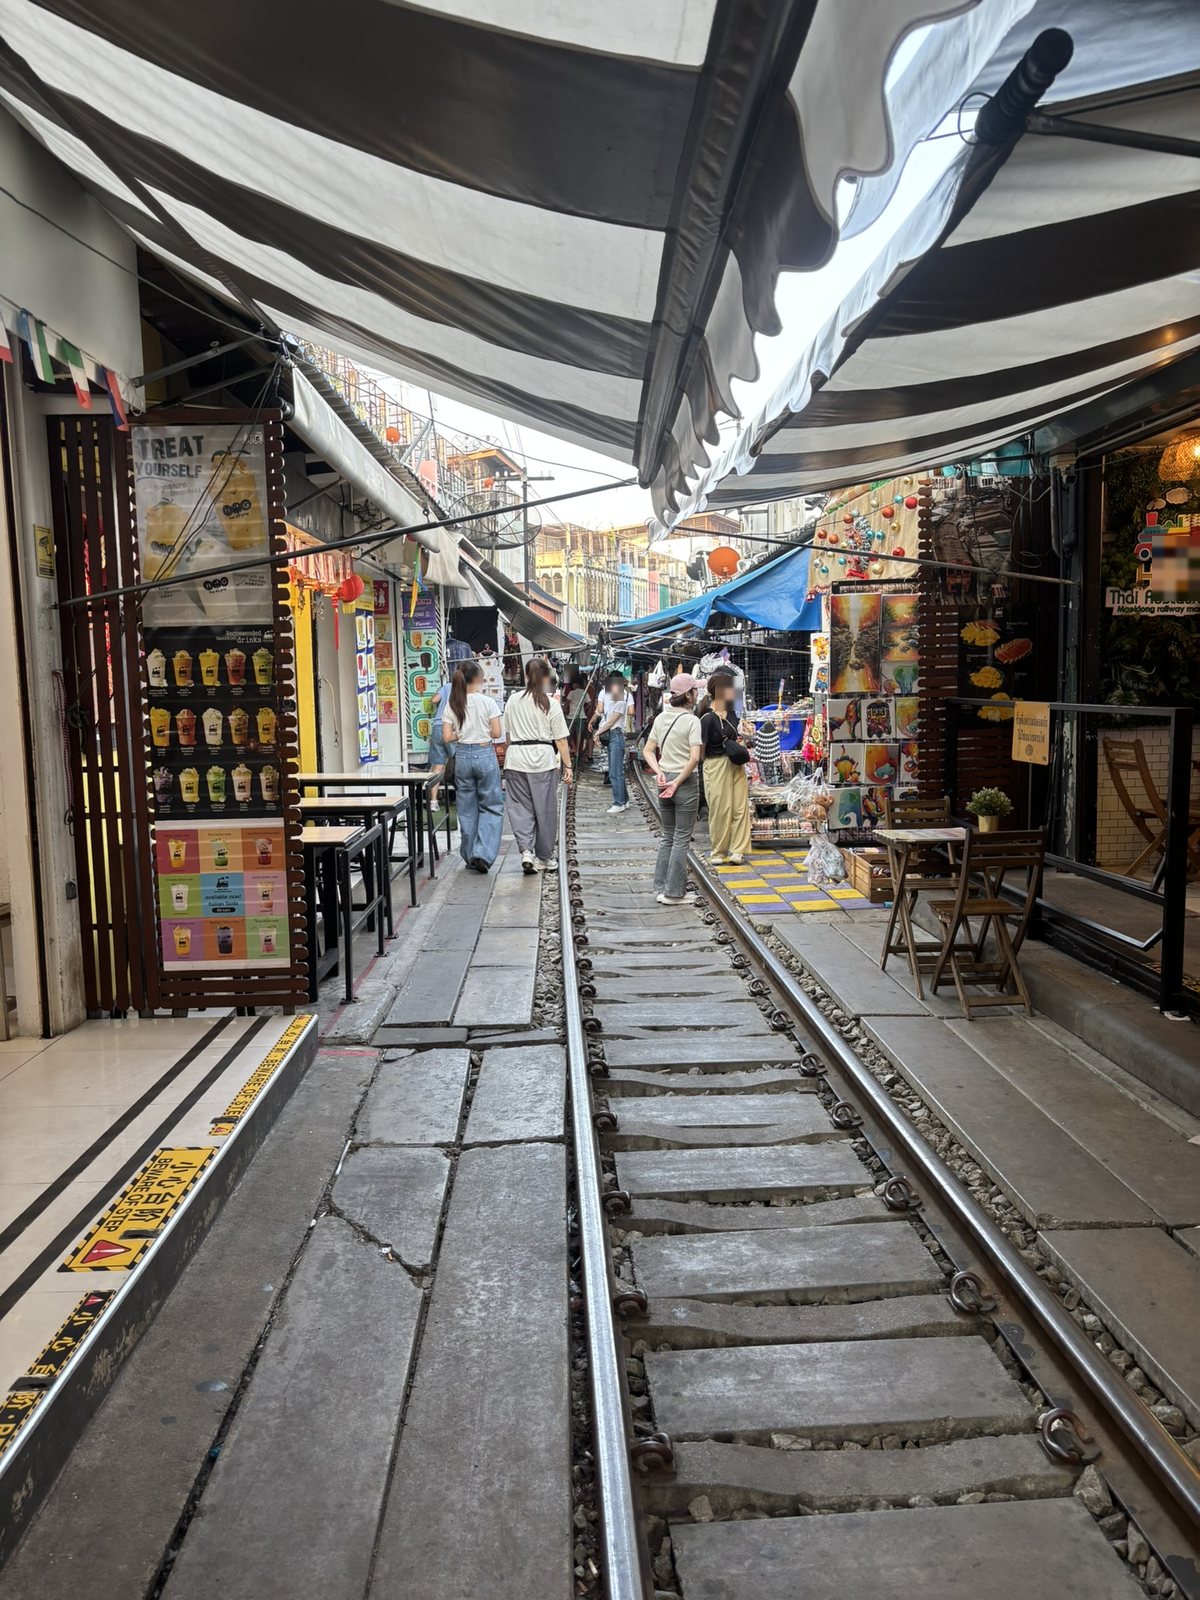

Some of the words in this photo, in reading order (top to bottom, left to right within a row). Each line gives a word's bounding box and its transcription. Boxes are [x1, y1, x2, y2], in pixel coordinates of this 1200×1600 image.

[137, 435, 204, 460] TREAT
[135, 462, 202, 479] YOURSELF
[1109, 589, 1138, 604] Thai
[248, 1059, 279, 1087] BEWARE
[241, 1088, 256, 1100] OF
[227, 1100, 248, 1119] STE
[133, 1157, 173, 1193] BEWARE
[123, 1193, 144, 1207] OF
[128, 1161, 197, 1223] 小心台阶
[103, 1207, 133, 1233] STEP
